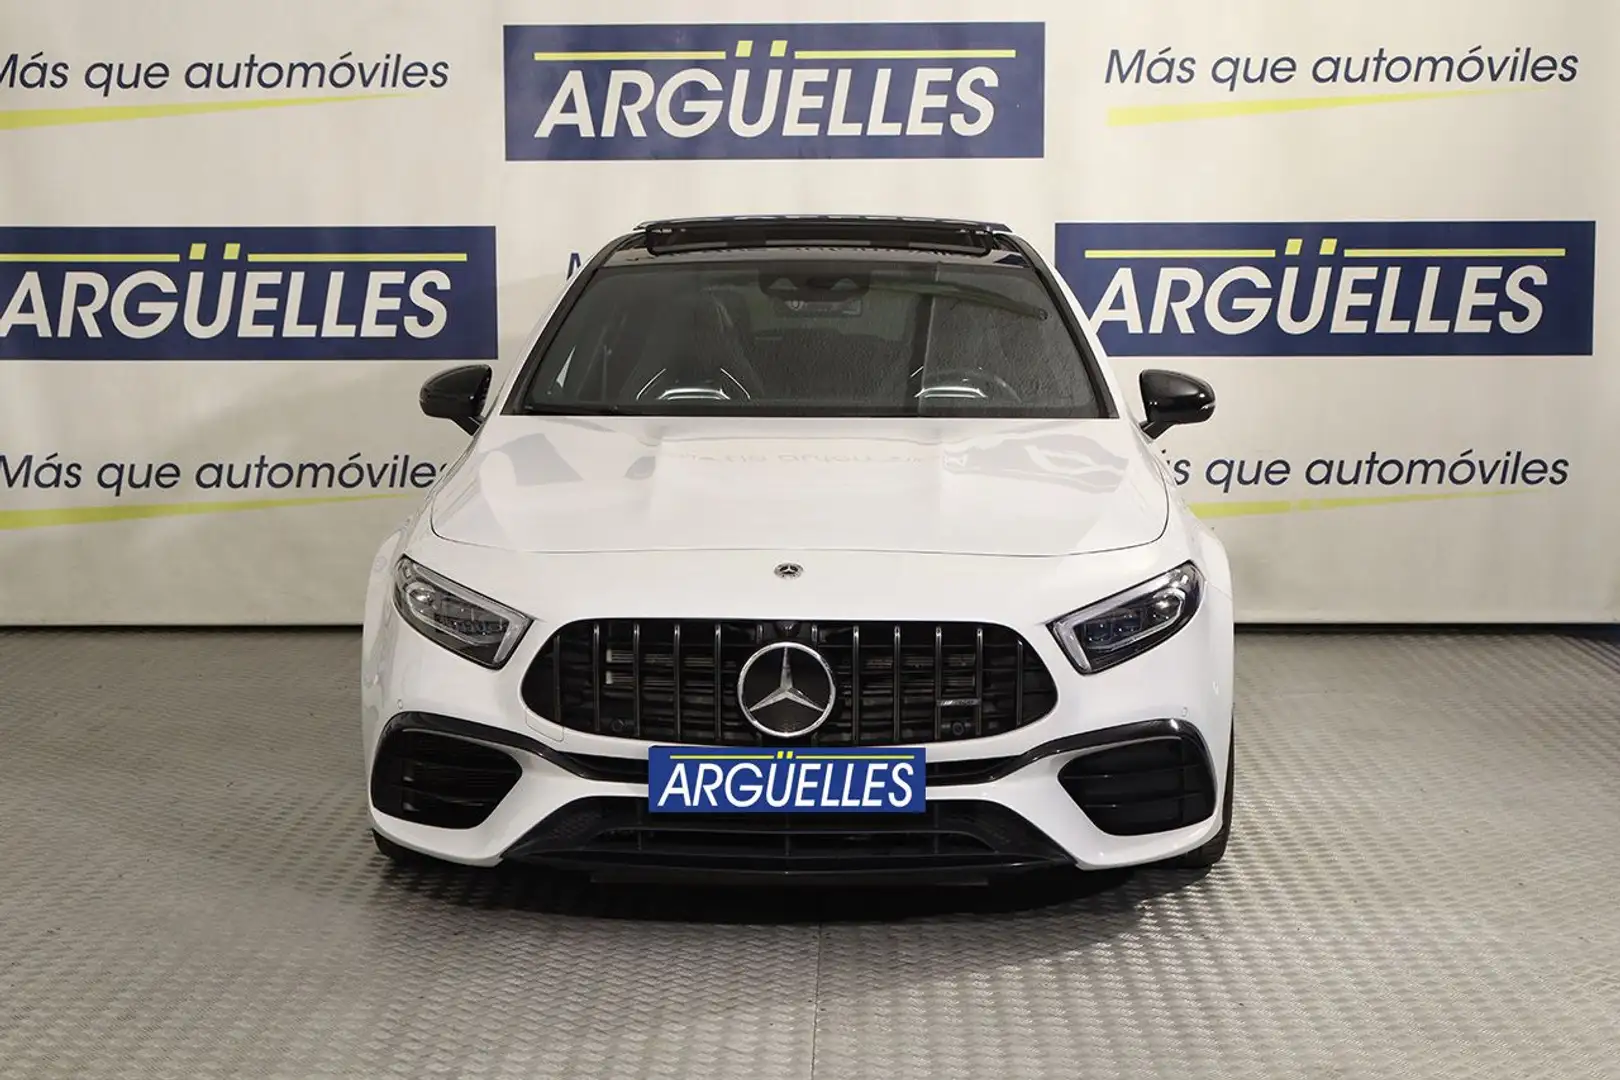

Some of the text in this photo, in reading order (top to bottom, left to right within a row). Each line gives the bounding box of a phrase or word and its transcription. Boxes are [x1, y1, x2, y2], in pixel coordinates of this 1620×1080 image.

[85, 62, 169, 97] que
[185, 52, 449, 89] automóviles
[535, 40, 999, 138] ARGÜELLES
[1105, 46, 1579, 91] Más que automóviles
[0, 243, 451, 338] ARGÜELLES
[1089, 239, 1548, 335] ARGÜELLES
[0, 452, 448, 498] Más que automóvile
[1205, 459, 1291, 494] que
[1305, 449, 1570, 486] automóviles
[657, 751, 914, 808] ARGÜELLES
